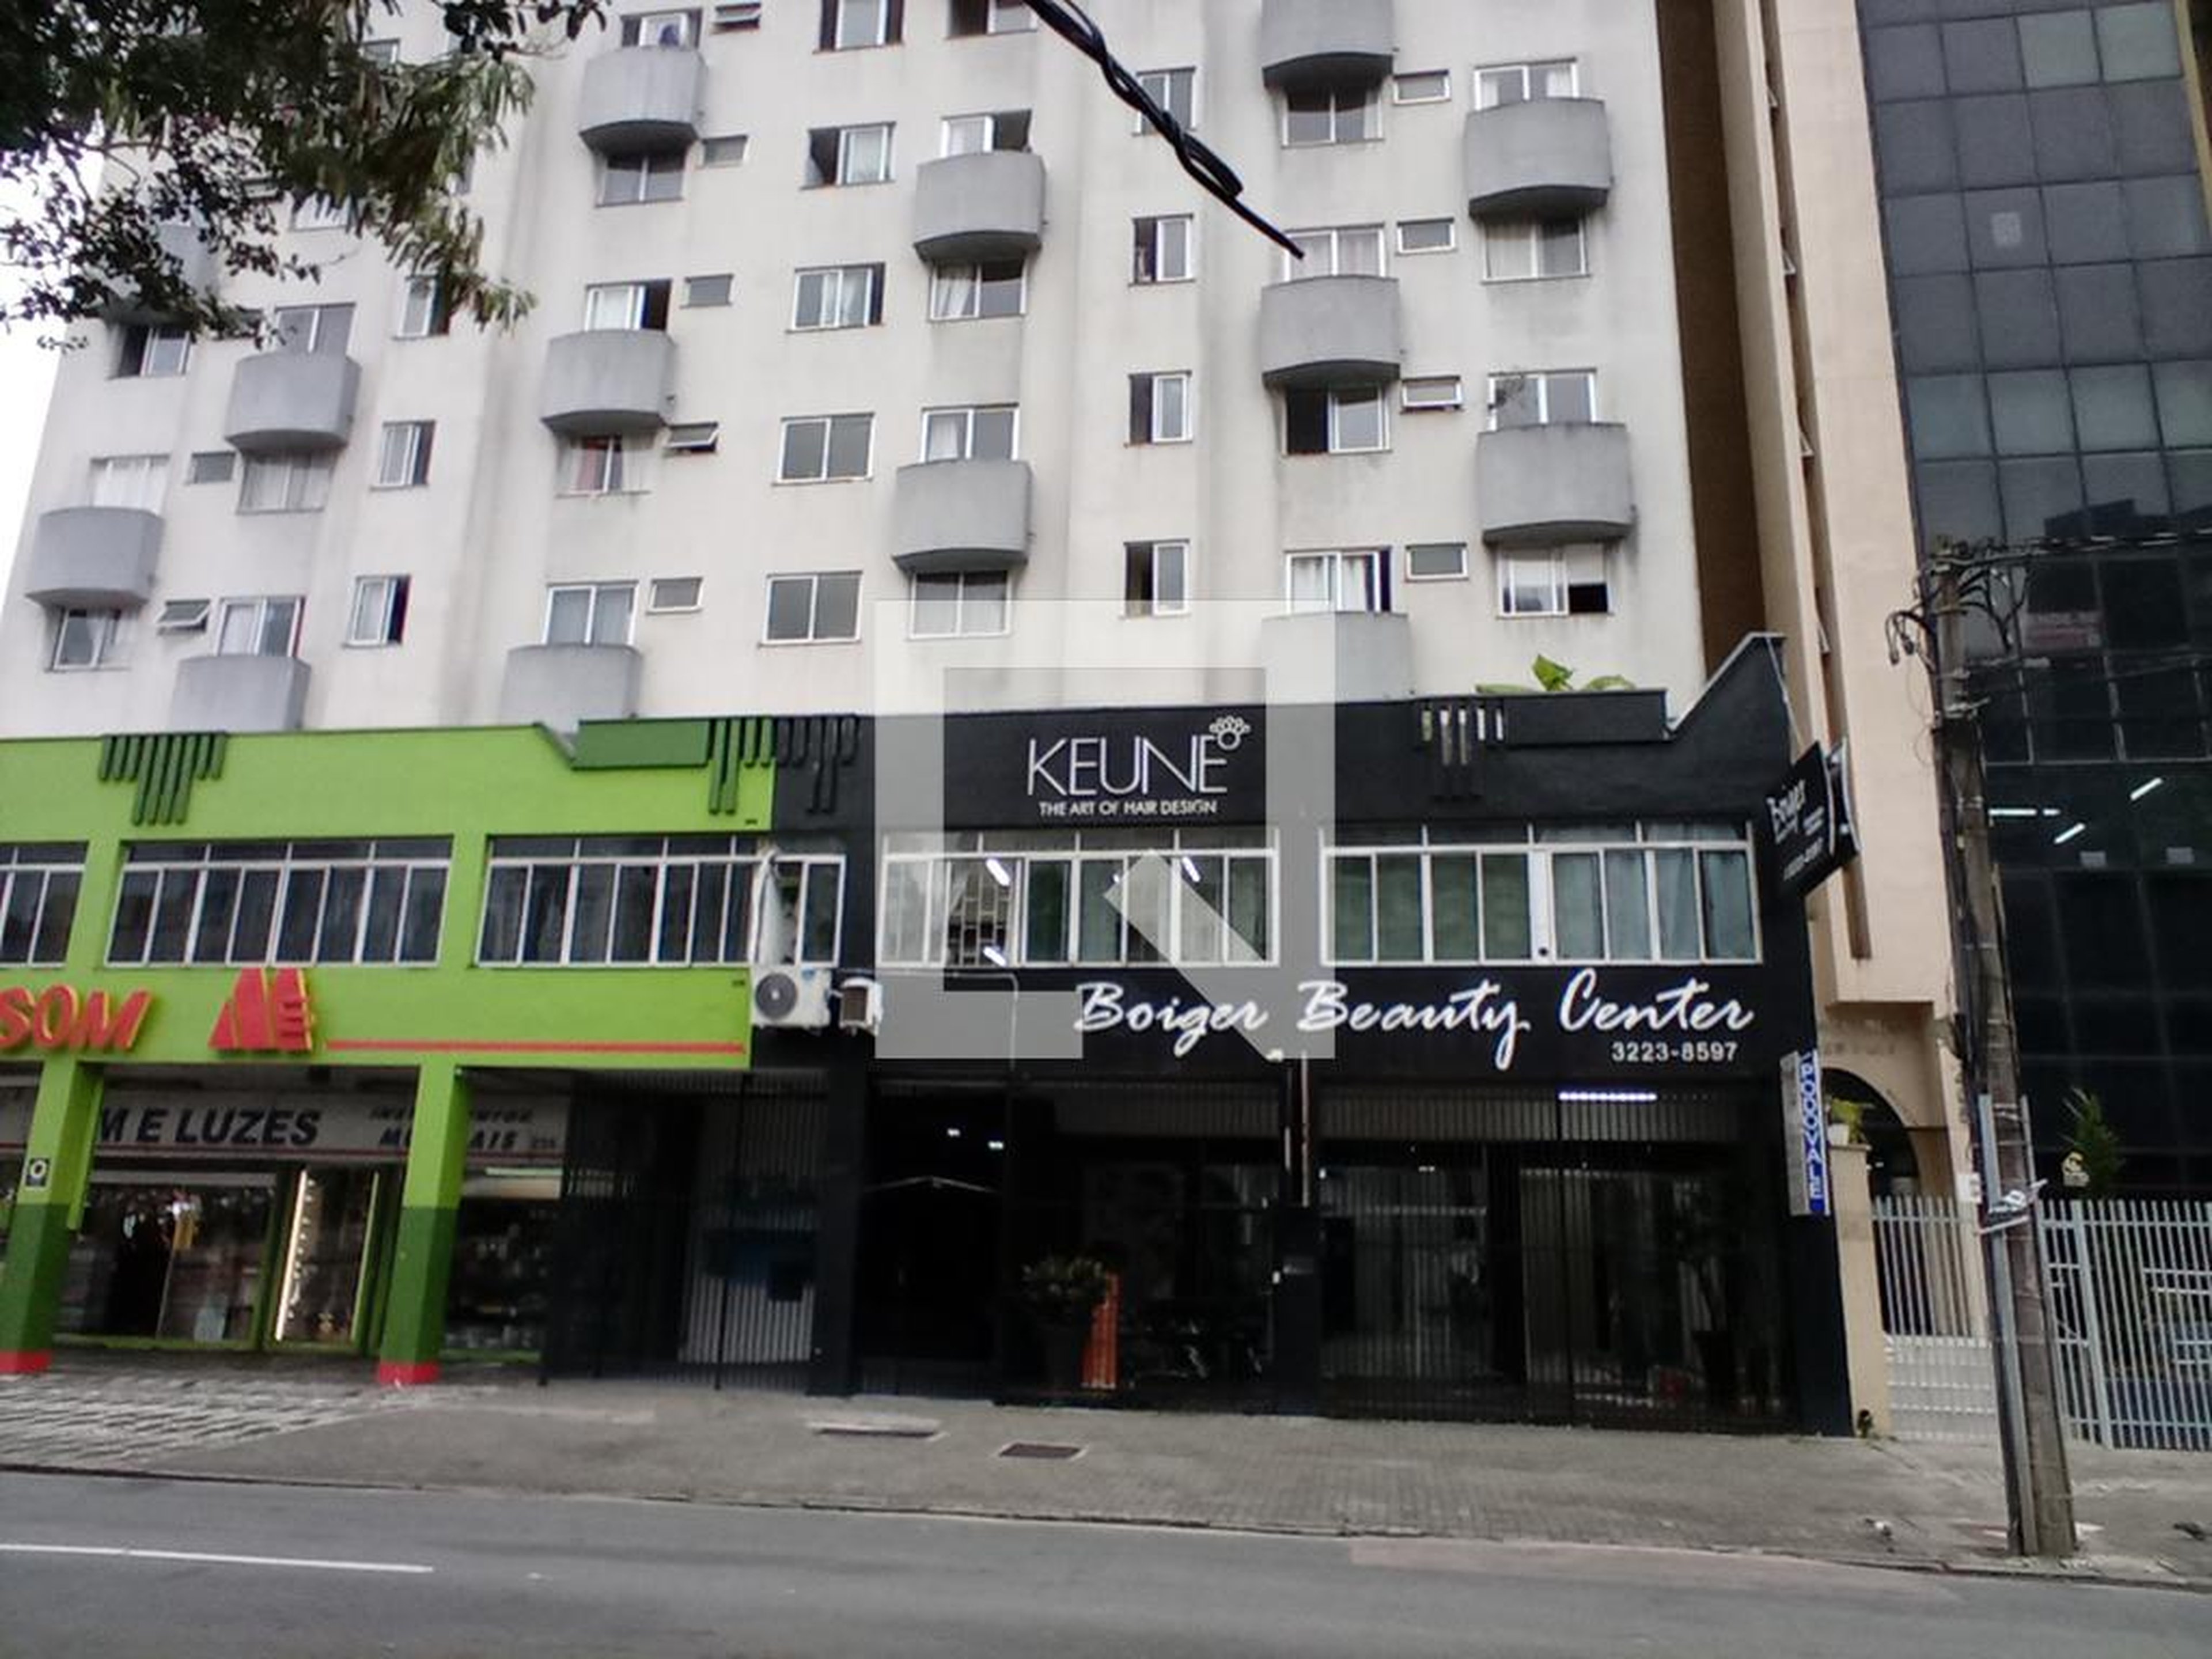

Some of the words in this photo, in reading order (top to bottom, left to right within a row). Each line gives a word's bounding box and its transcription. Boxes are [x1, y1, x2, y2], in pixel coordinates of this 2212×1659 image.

[1027, 734, 1228, 796] KEUNE
[1039, 801, 1067, 816] THE
[1070, 801, 1096, 815] ART
[1099, 800, 1120, 815] OF
[1123, 800, 1158, 815] HAIR
[1160, 799, 1218, 815] DESIGN
[0, 983, 152, 1051] SOM
[1073, 981, 1268, 1058] Boiger
[1297, 978, 1531, 1071] Beauty
[1559, 968, 1755, 1031] Center
[1612, 1041, 1738, 1062] 3223-8597
[175, 1108, 321, 1146] LUZES
